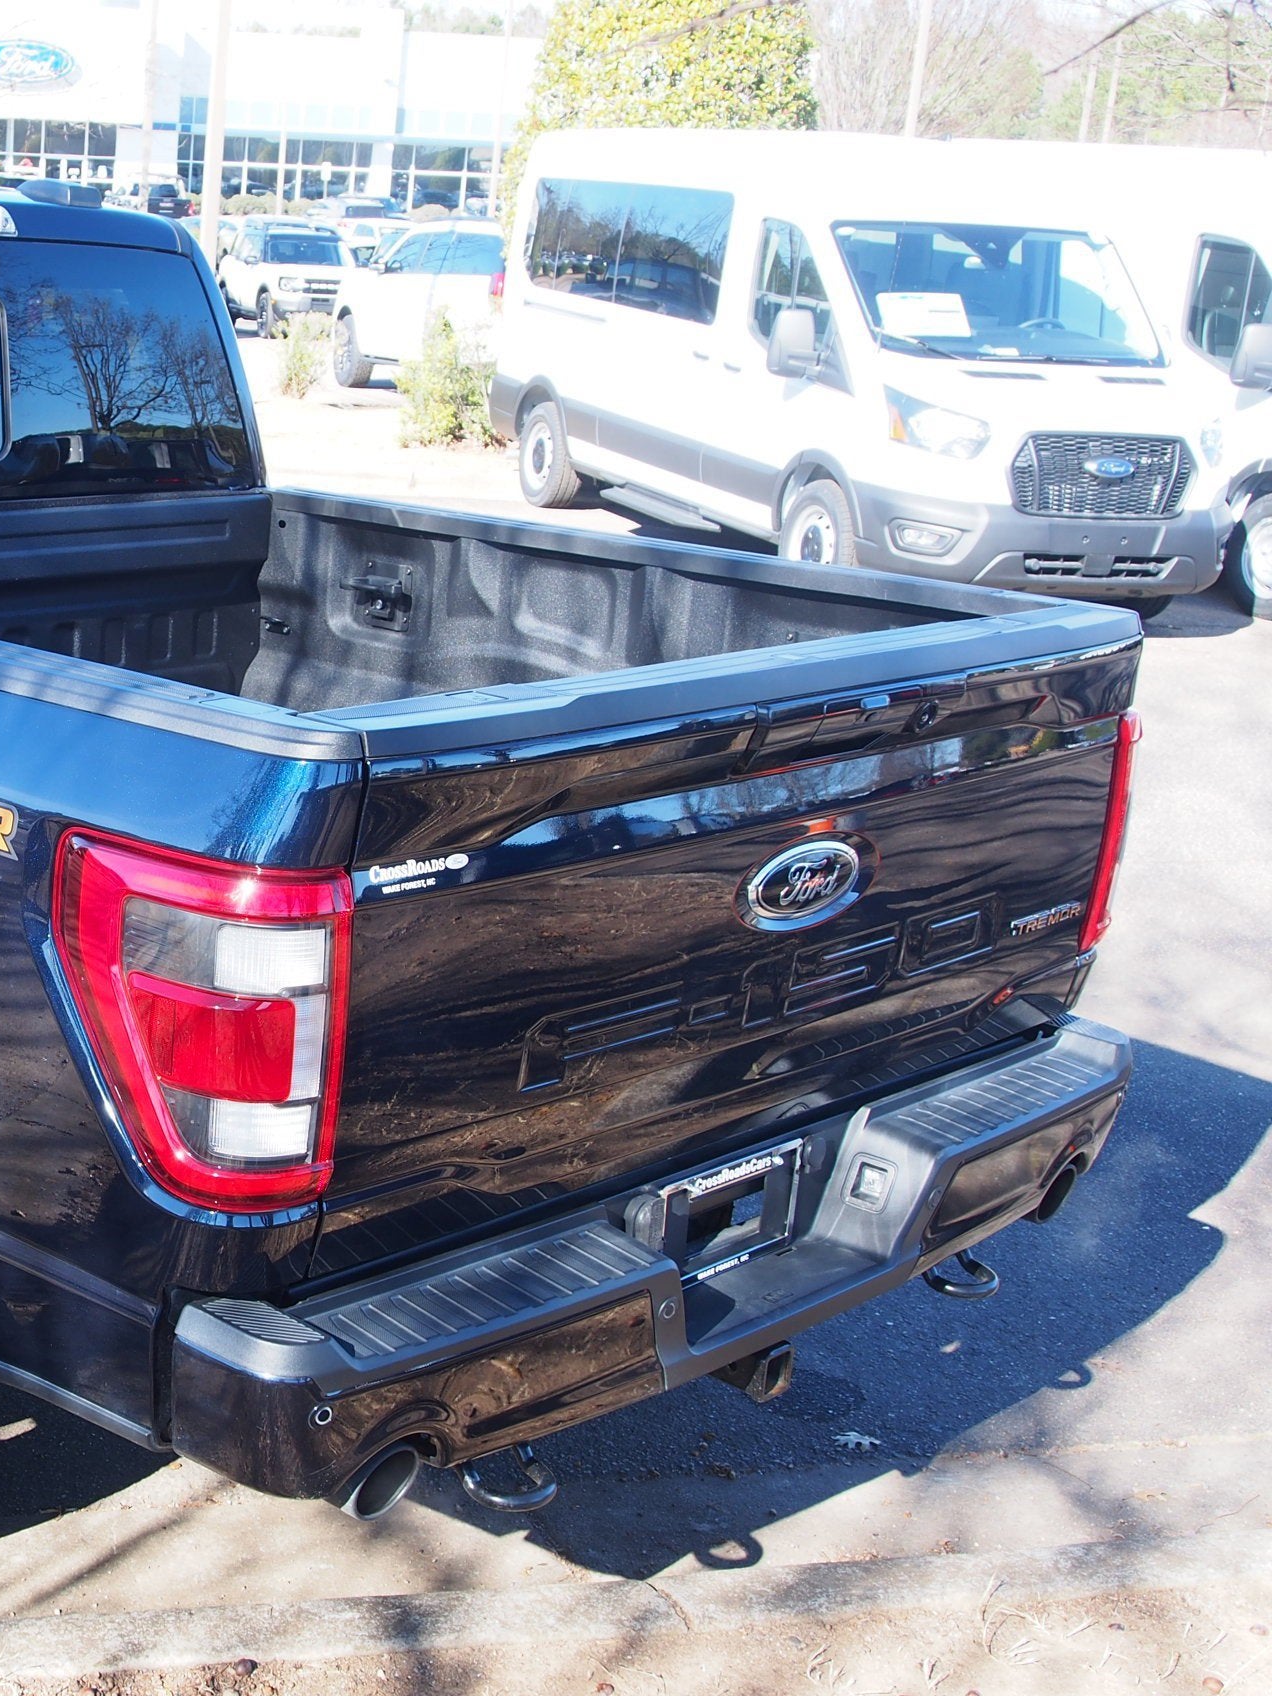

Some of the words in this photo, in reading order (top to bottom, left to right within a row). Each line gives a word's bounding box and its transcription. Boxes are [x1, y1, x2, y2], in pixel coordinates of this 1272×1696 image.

[778, 857, 842, 907] Ford
[1013, 901, 1081, 936] TREMOR
[518, 893, 997, 1093] F-150
